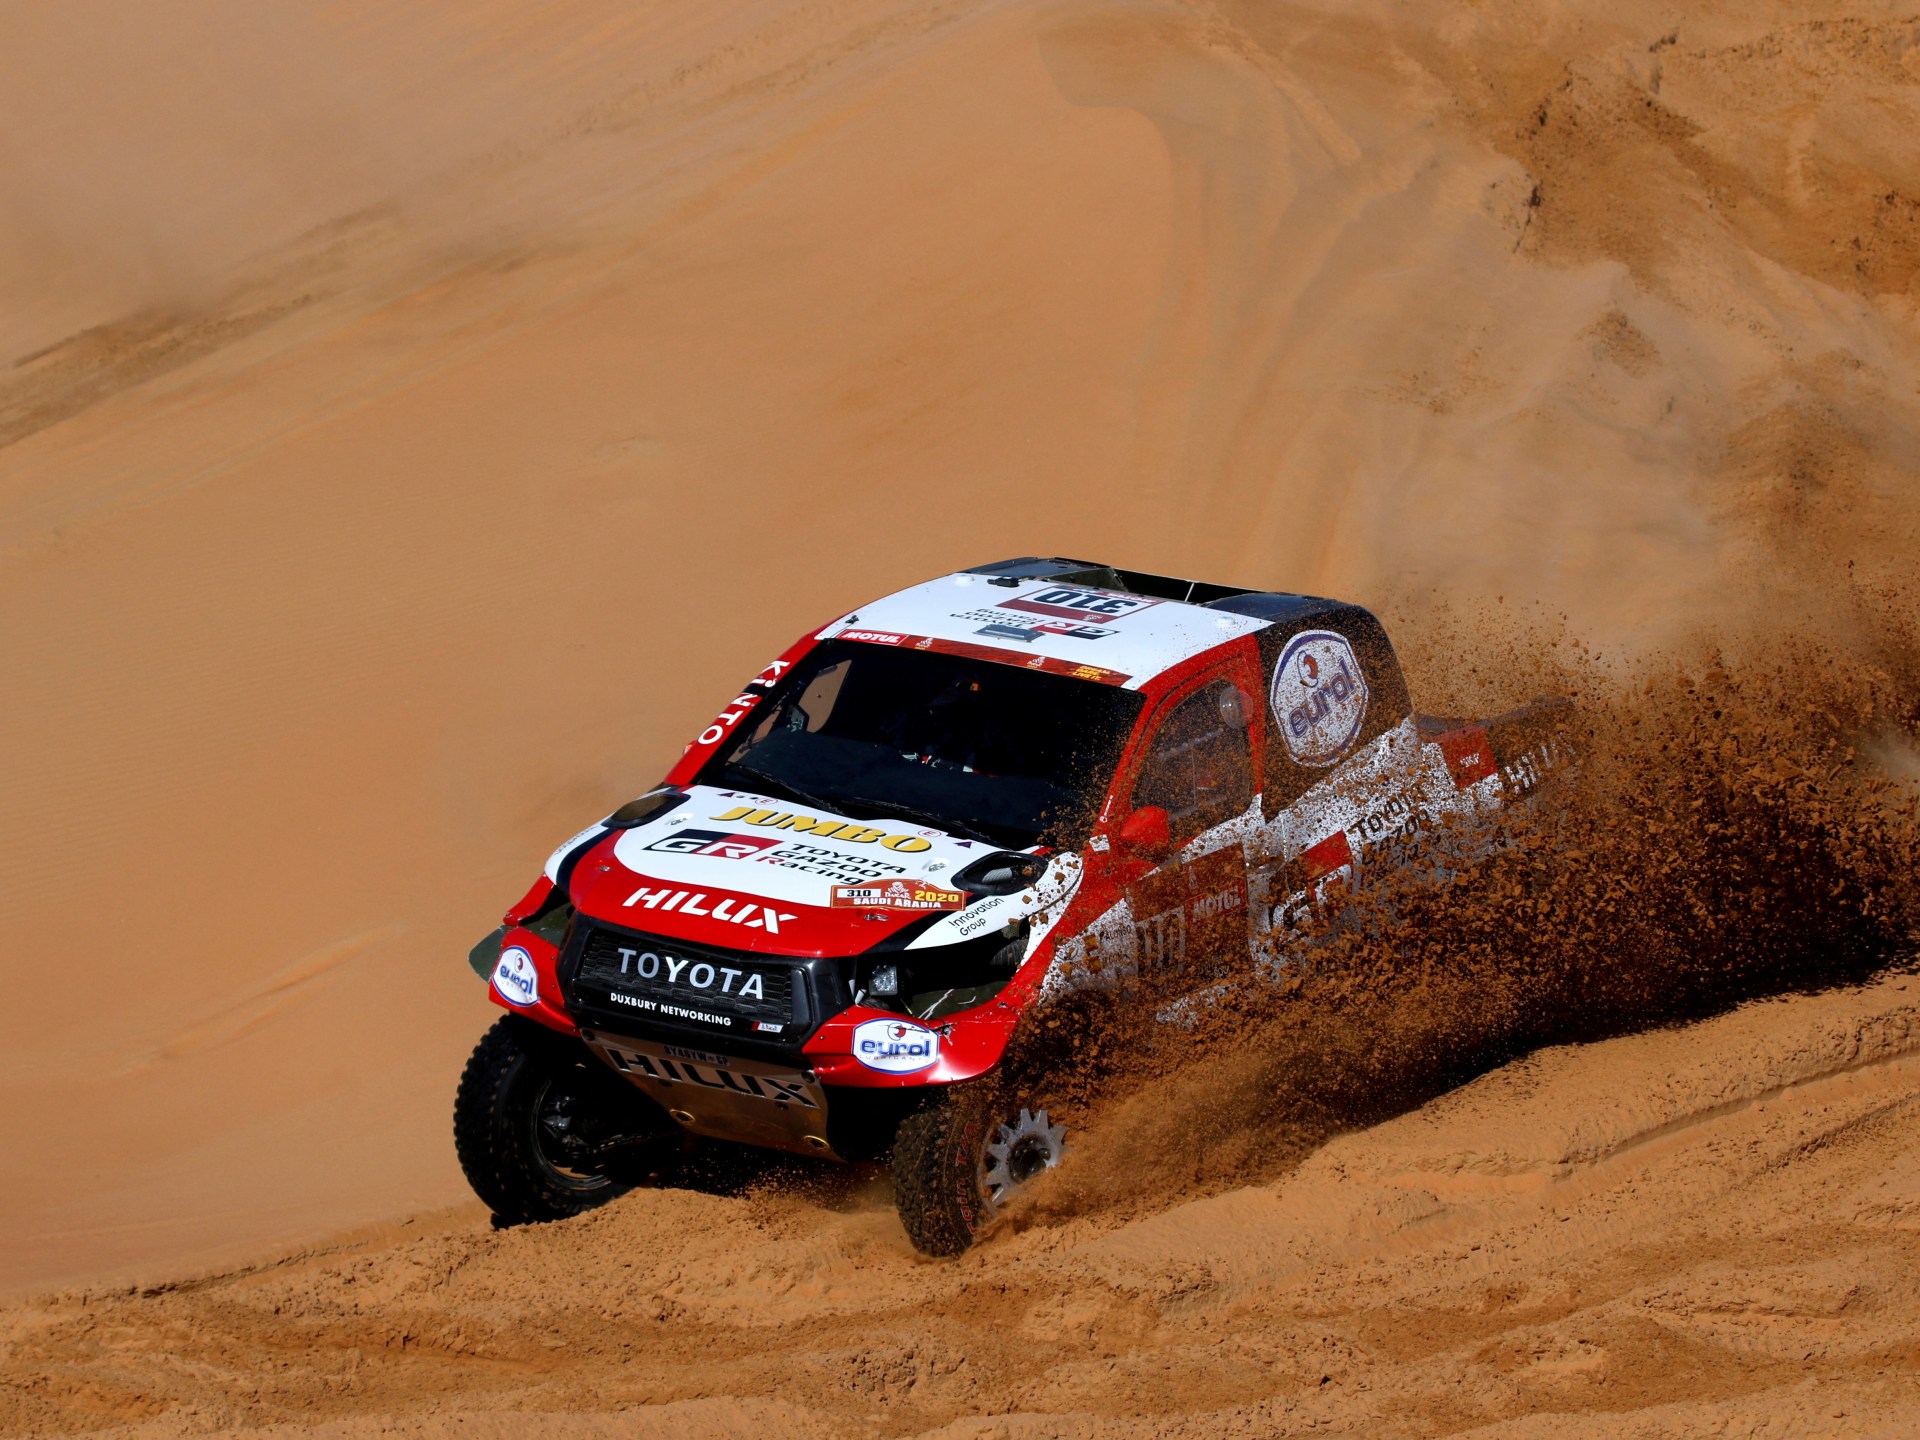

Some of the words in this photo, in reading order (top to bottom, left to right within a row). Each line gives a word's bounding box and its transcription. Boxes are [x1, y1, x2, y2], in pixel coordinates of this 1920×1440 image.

[1033, 590, 1139, 614] 310
[844, 631, 900, 644] MOTUL
[1040, 621, 1114, 635] GR
[1289, 657, 1355, 738] eurol
[708, 806, 932, 853] JUMBO
[651, 837, 760, 860] GR
[793, 844, 907, 875] TOYOTA
[755, 855, 865, 885] Racing
[771, 850, 882, 878] GAZOO
[622, 887, 798, 934] HILUX
[847, 889, 871, 897] 310
[914, 890, 959, 903] 2020
[853, 897, 891, 906] SAUDI
[894, 898, 942, 909] ARABIA
[949, 897, 1005, 929] Innovation
[959, 917, 987, 937] Group
[617, 947, 764, 1000] TOYOTA
[610, 992, 657, 1011] DUXBURY
[660, 1004, 732, 1026] NETWORKING
[860, 1039, 931, 1057] eurol
[606, 1048, 819, 1108] HILUX
